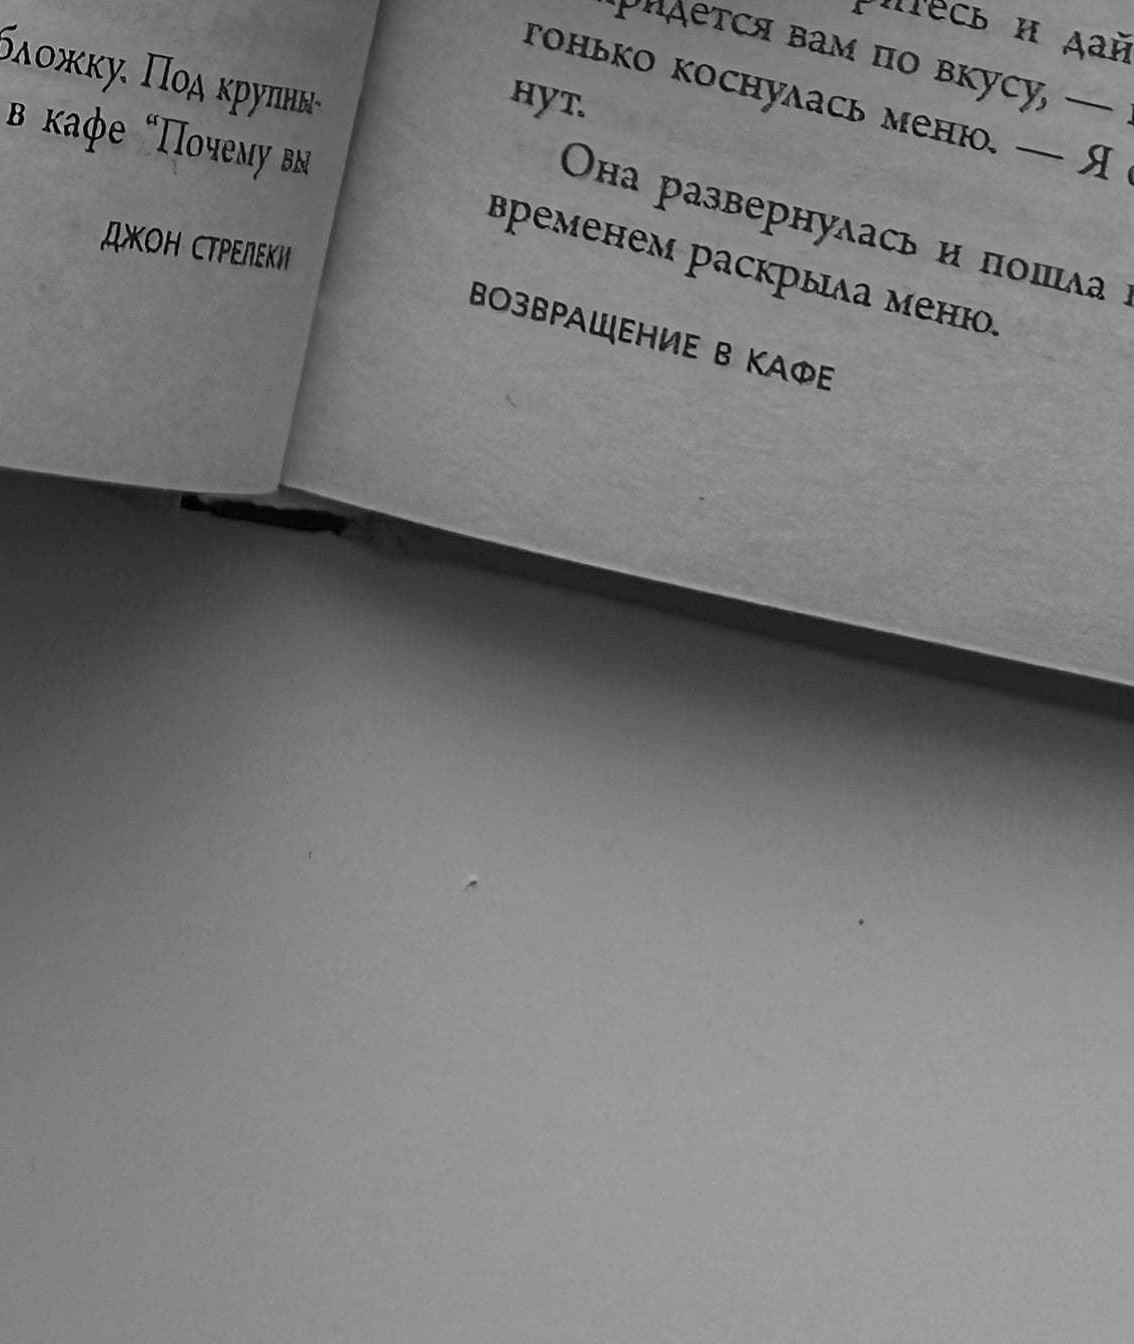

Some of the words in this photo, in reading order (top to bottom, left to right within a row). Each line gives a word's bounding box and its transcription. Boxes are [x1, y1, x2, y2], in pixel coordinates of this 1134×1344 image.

[139, 51, 205, 103] Под
[509, 79, 586, 120] нут.
[522, 21, 656, 73] гонько
[670, 57, 866, 123] коснулась
[880, 106, 998, 155] меню.
[785, 24, 858, 62] вам
[871, 44, 921, 75] по
[933, 58, 1048, 114] вкусу,
[41, 106, 126, 154] кафе
[100, 220, 182, 258] ДЖОН
[486, 193, 678, 262] временем
[683, 243, 872, 308] раскрыла
[883, 288, 1000, 337] меню.
[560, 142, 639, 193] Она
[652, 175, 918, 256] развернулась
[978, 250, 1106, 301] пошла
[469, 280, 702, 360] ВОЗВРАЩЕНИЕ
[745, 347, 836, 392] КАФЕ
